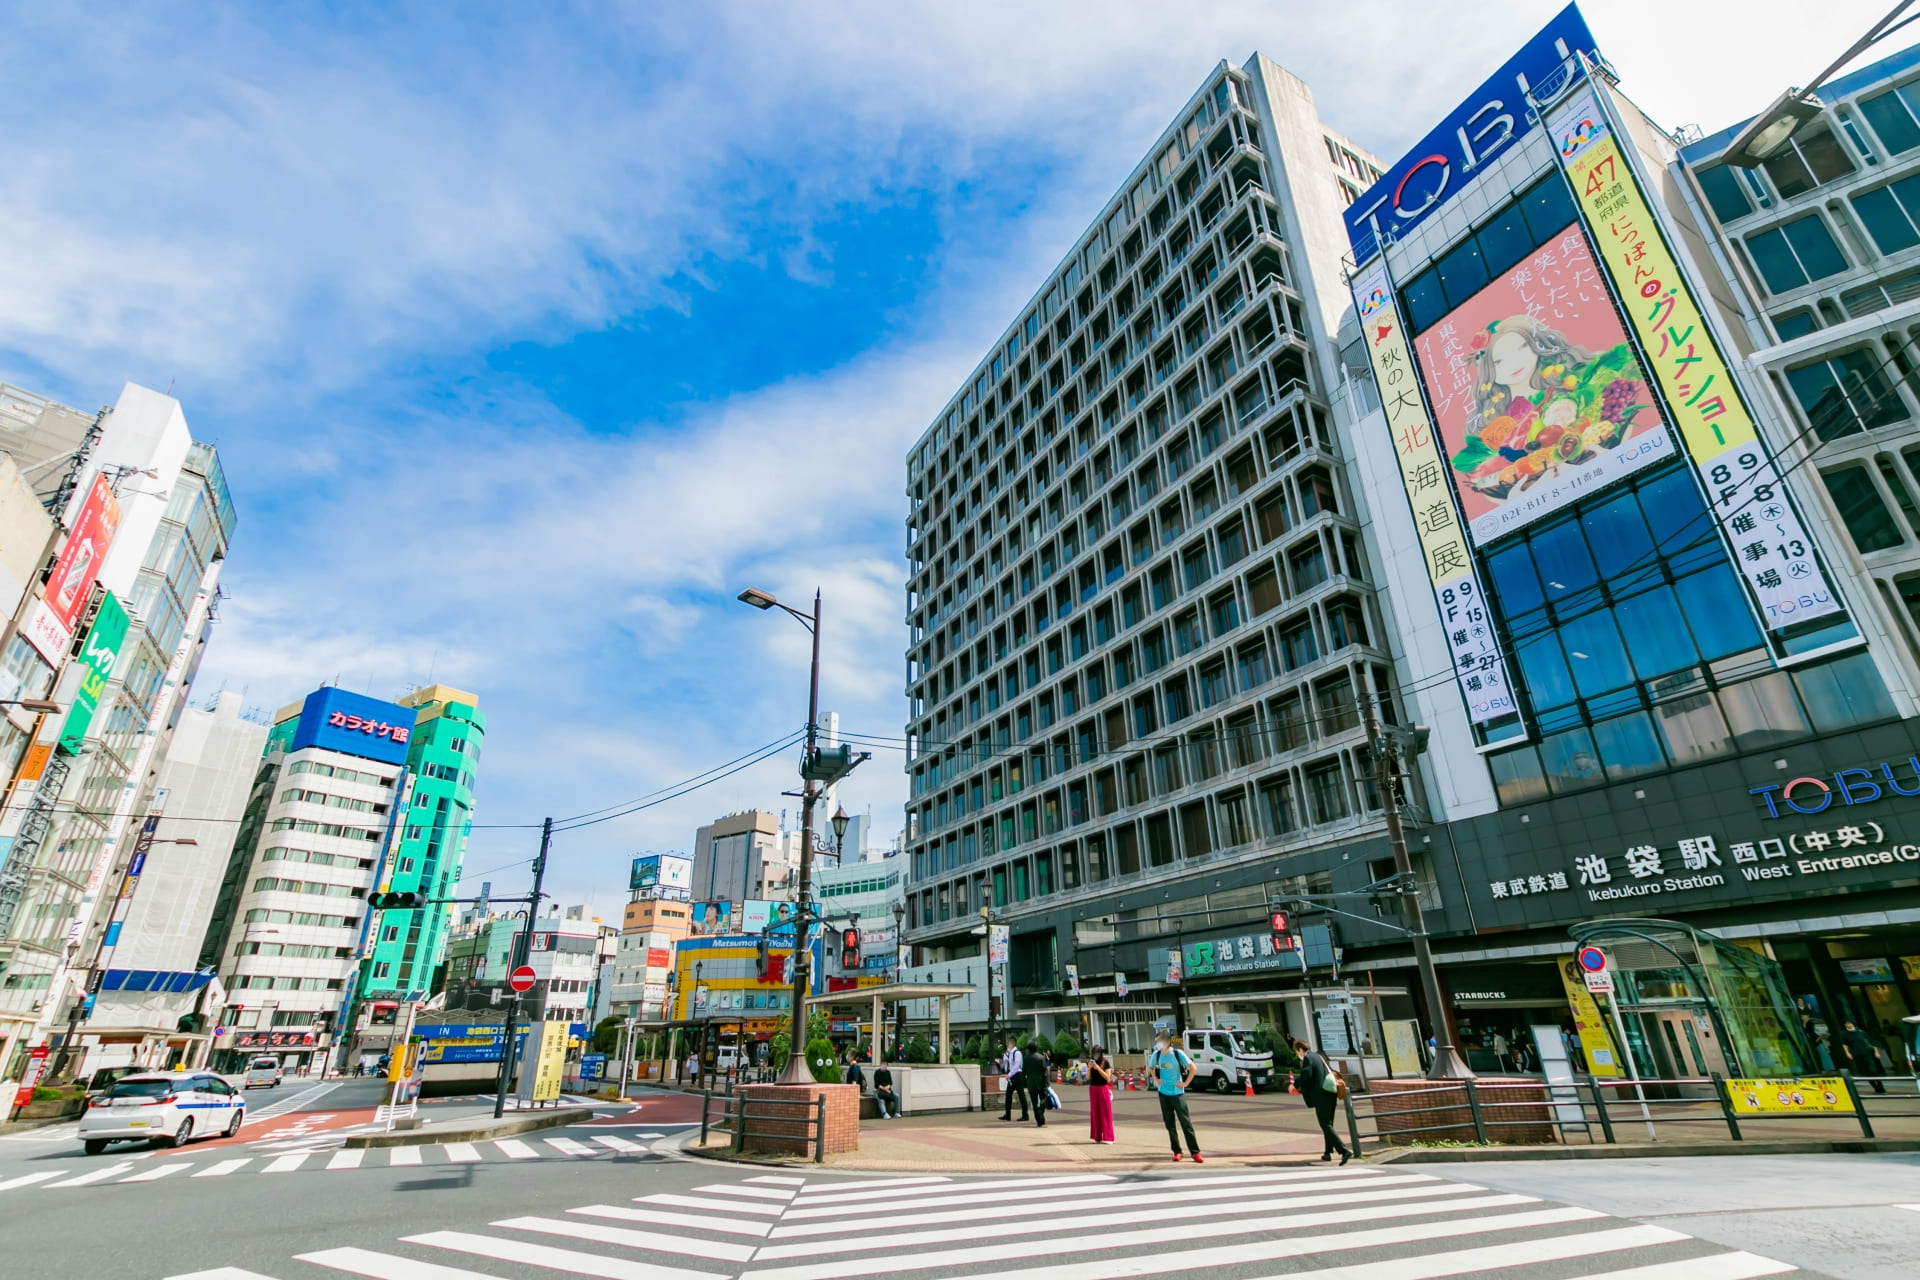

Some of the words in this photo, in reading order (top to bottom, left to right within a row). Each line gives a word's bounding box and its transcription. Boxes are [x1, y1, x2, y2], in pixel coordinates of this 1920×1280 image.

[1353, 37, 1577, 245] TOBU
[1584, 154, 1616, 198] 47
[1617, 436, 1664, 465] TOBU
[1767, 589, 1831, 617] TOBU
[1472, 696, 1509, 713] TOBU
[329, 711, 410, 743] カラオケ館
[1749, 756, 1920, 819] TOBU
[1490, 871, 1569, 900] 東武鉄道
[1574, 835, 1723, 886] 池袋駅
[1741, 863, 1793, 882] West
[1588, 882, 1661, 902] Ikebukuro
[1663, 873, 1725, 892] Station
[1186, 942, 1215, 966] JR
[1219, 961, 1254, 974] Ikebukuro
[1255, 959, 1280, 970] Station
[1454, 991, 1507, 1000] STARBUCKS
[439, 1027, 450, 1036] IN
